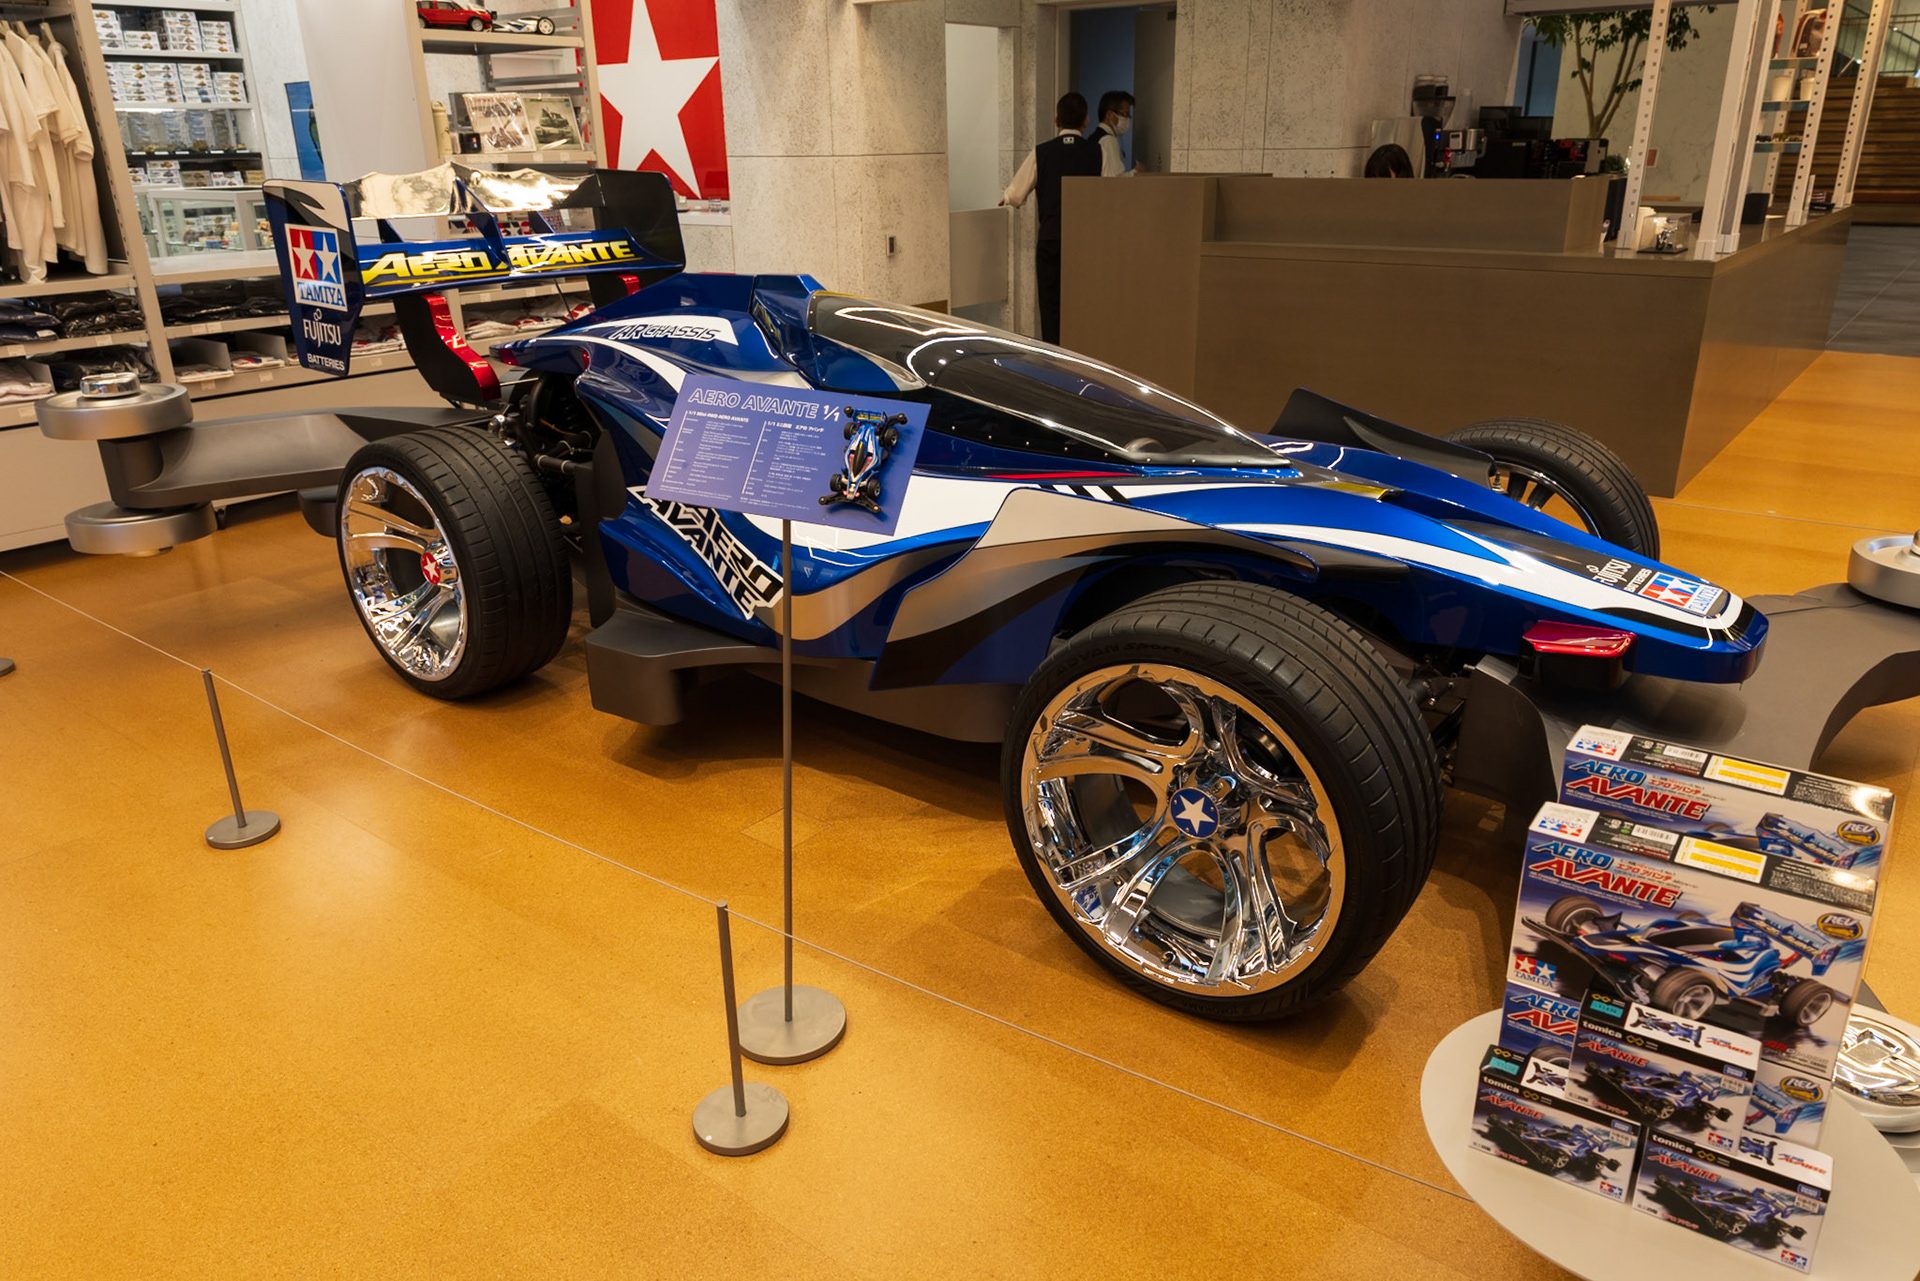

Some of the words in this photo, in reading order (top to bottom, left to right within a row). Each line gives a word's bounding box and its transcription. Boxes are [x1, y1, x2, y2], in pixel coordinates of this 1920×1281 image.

[361, 251, 491, 285] AERO
[496, 240, 635, 270] AVANTE
[297, 282, 345, 307] TAMIYA
[302, 318, 342, 348] FUJITSU
[307, 352, 345, 371] BATTERIES
[688, 387, 742, 409] AERO
[741, 394, 820, 419] AVANTE
[822, 405, 840, 422] 1/1
[730, 415, 749, 423] AVANTE
[1592, 558, 1632, 586] FUJITSU
[1623, 568, 1652, 593] BATTERIES
[1688, 586, 1721, 612] TAMIYA
[1569, 759, 1646, 785] AERO
[1566, 775, 1710, 820] AVANTE
[1648, 778, 1671, 790] エアロ
[1671, 783, 1701, 795] アバンテ
[1843, 823, 1877, 833] REV
[1532, 840, 1613, 868] AERO
[1529, 858, 1682, 908] AVANTE
[1616, 862, 1641, 874] エアロ
[1641, 868, 1673, 882] アバンテ
[1824, 916, 1859, 926] REV
[1514, 970, 1554, 988] TAMIYA
[1582, 1020, 1622, 1039] tomica
[1577, 1041, 1650, 1068] AVANTE
[1483, 1076, 1519, 1093] tomica
[1785, 1078, 1818, 1089] REV
[1480, 1095, 1544, 1120] AVANTE
[1651, 1134, 1693, 1154] tomica
[1647, 1154, 1721, 1182] AVANTE
